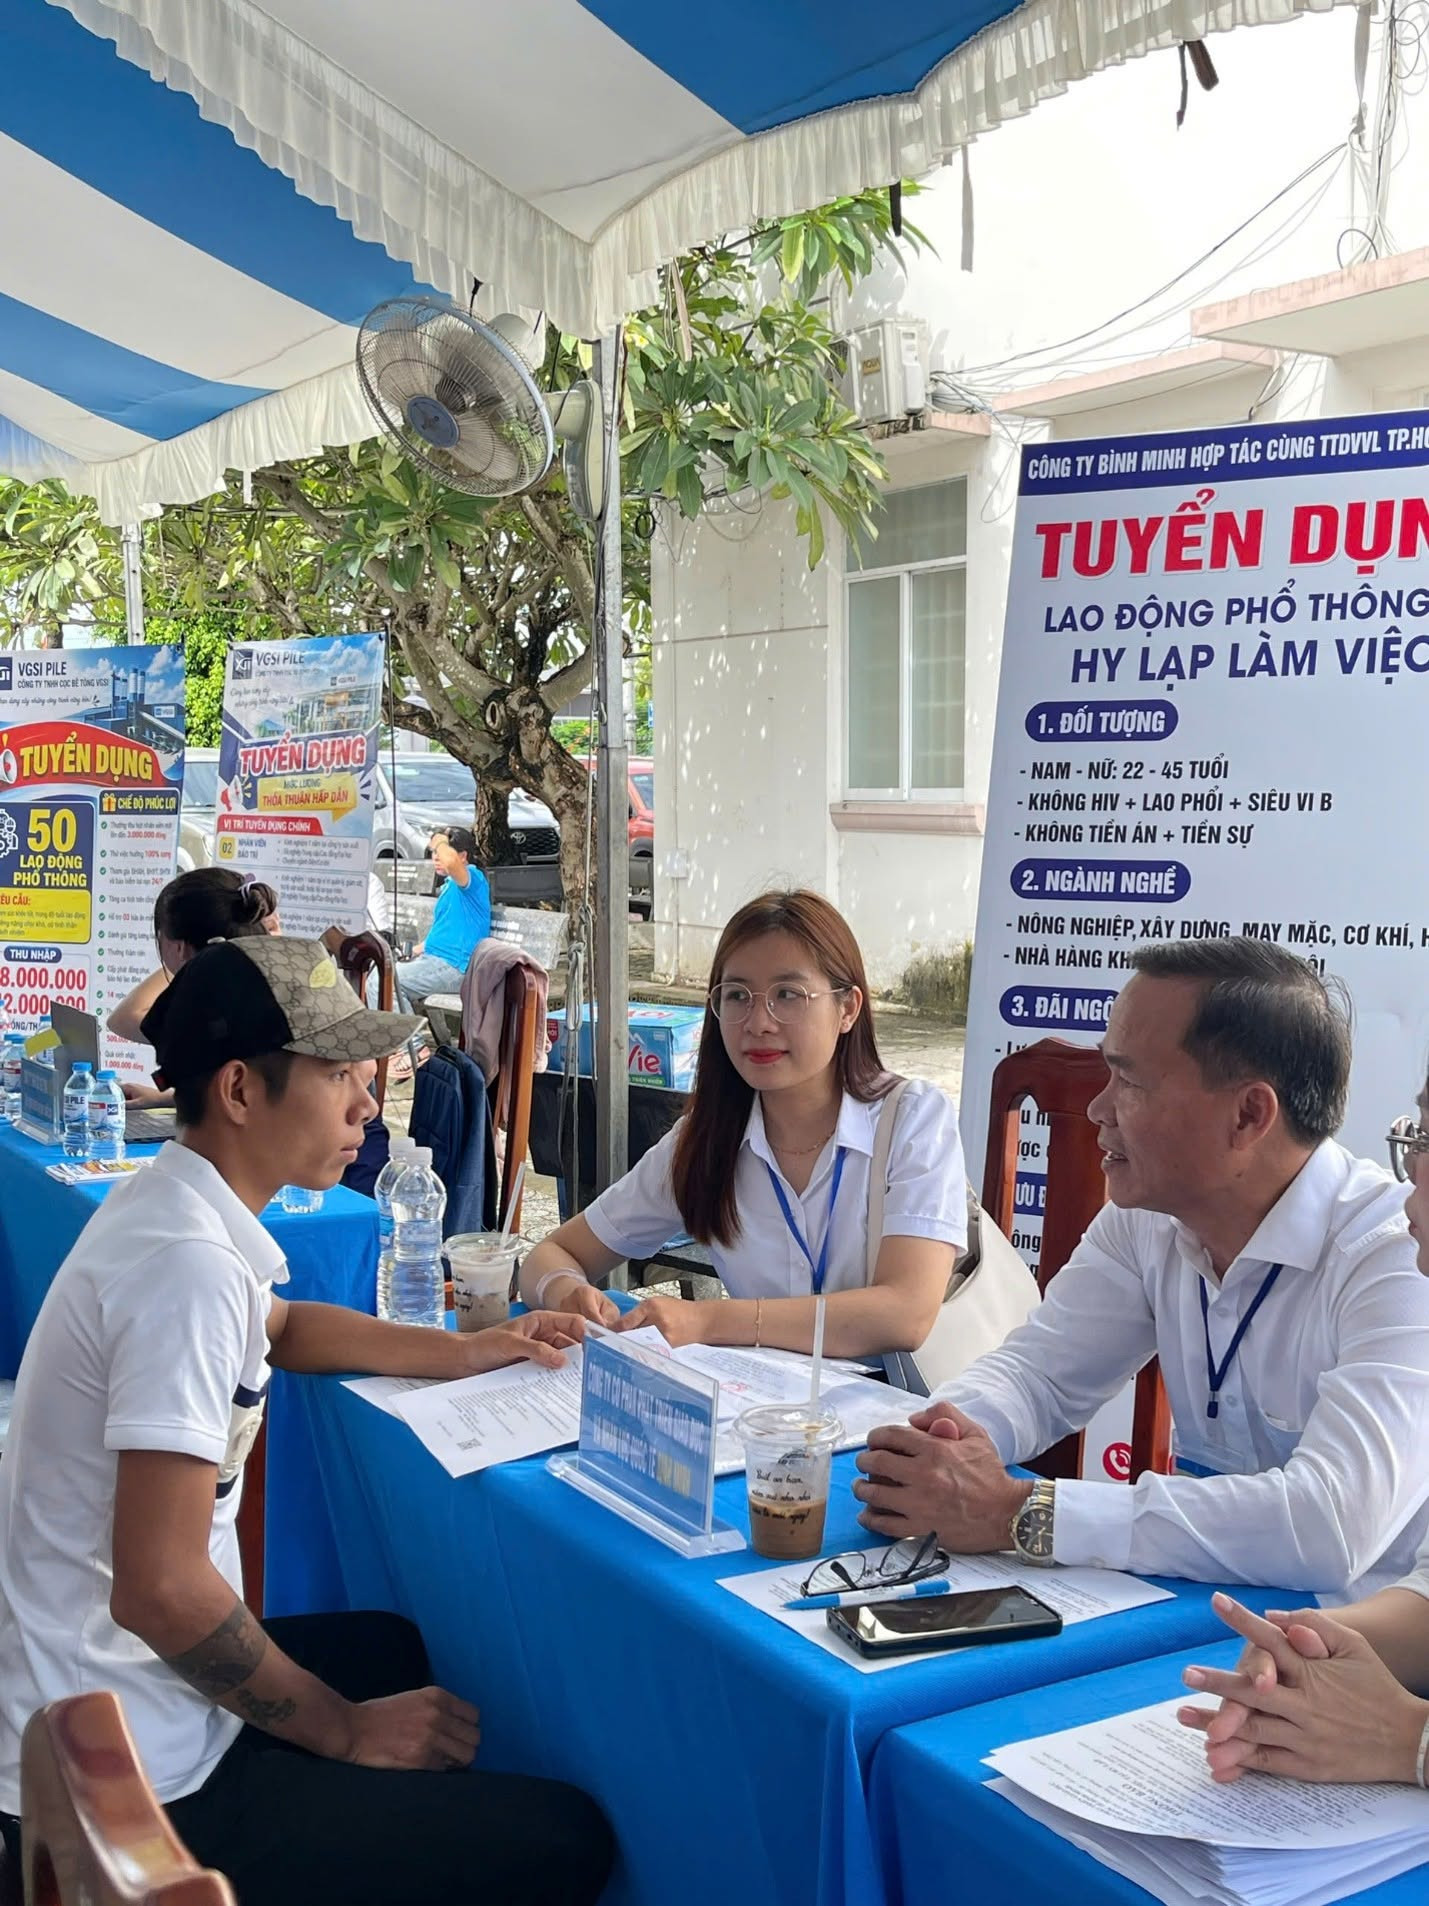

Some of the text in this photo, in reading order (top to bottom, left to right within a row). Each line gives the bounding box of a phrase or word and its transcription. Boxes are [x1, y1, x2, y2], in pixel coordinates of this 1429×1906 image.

[1028, 455, 1071, 480] CÔNG
[1076, 457, 1094, 476] TY
[1098, 451, 1138, 475] BÌNH
[1142, 448, 1185, 472] MINH
[1190, 444, 1225, 471] HỢP
[1230, 438, 1262, 463] TÁC
[1267, 434, 1315, 461] CÙNG
[1320, 432, 1381, 457] TTDVVL
[1036, 488, 1264, 579] TUYỂN
[1044, 578, 1429, 637] LAO ĐỘNG PHỔ THÔNG
[18, 662, 42, 676] VGSI
[47, 662, 67, 676] PILE
[256, 652, 281, 666] VGSI
[283, 652, 304, 664] PILE
[1072, 626, 1429, 691] HY LẠP LÀM VIỆC
[18, 678, 34, 689] CÔNG
[34, 680, 42, 688] TY
[44, 680, 58, 688] TNHH
[96, 678, 108, 688] VGSI
[1038, 705, 1165, 738] 1. ĐỐI TƯỢNG
[20, 732, 152, 783] TUYỂN DỤNG
[240, 731, 366, 775] TUYỂN DỤNG
[1031, 761, 1071, 781] NAM
[1088, 758, 1117, 780] NỮ:
[1122, 761, 1144, 780] 22
[1160, 760, 1184, 780] 45
[1189, 753, 1229, 779] TUỔI
[118, 793, 132, 809] CHẾ
[134, 795, 144, 811] ĐỘ
[145, 795, 164, 809] PHÚC
[1028, 789, 1086, 812] KHÔNG
[1091, 793, 1120, 812] HIV
[1142, 794, 1176, 812] LAO
[1180, 786, 1223, 812] PHỔI
[1248, 788, 1290, 811] SIÊU
[1296, 792, 1314, 811] VI
[1320, 792, 1332, 811] B
[27, 808, 77, 852] 50
[1025, 820, 1083, 844] KHÔNG
[1088, 818, 1126, 844] TIỀN
[1132, 820, 1157, 844] ÁN
[1180, 818, 1220, 844] TIỀN
[1227, 823, 1254, 848] SỰ
[222, 842, 232, 854] 02
[20, 854, 82, 870] LAO ĐỘNG
[13, 867, 87, 888] PHỔ THÔNG
[1021, 864, 1178, 894] 2. NGÀNH NGHỀ
[0, 893, 30, 906] ÊU CẦU:
[1018, 912, 1064, 935] NÔNG
[1070, 914, 1136, 941] NGHIỆP,
[1140, 916, 1174, 938] XÂY
[1242, 923, 1281, 944] MAY
[1288, 920, 1336, 948] MẶC,
[1344, 924, 1370, 945] CƠ
[1376, 923, 1414, 949] KHÍ,
[10, 948, 57, 962] THU NHẬP
[1014, 944, 1050, 966] NHÀ
[1056, 948, 1102, 968] HÀNG
[1012, 996, 1028, 1017] 3.
[1035, 993, 1068, 1019] ĐÃI
